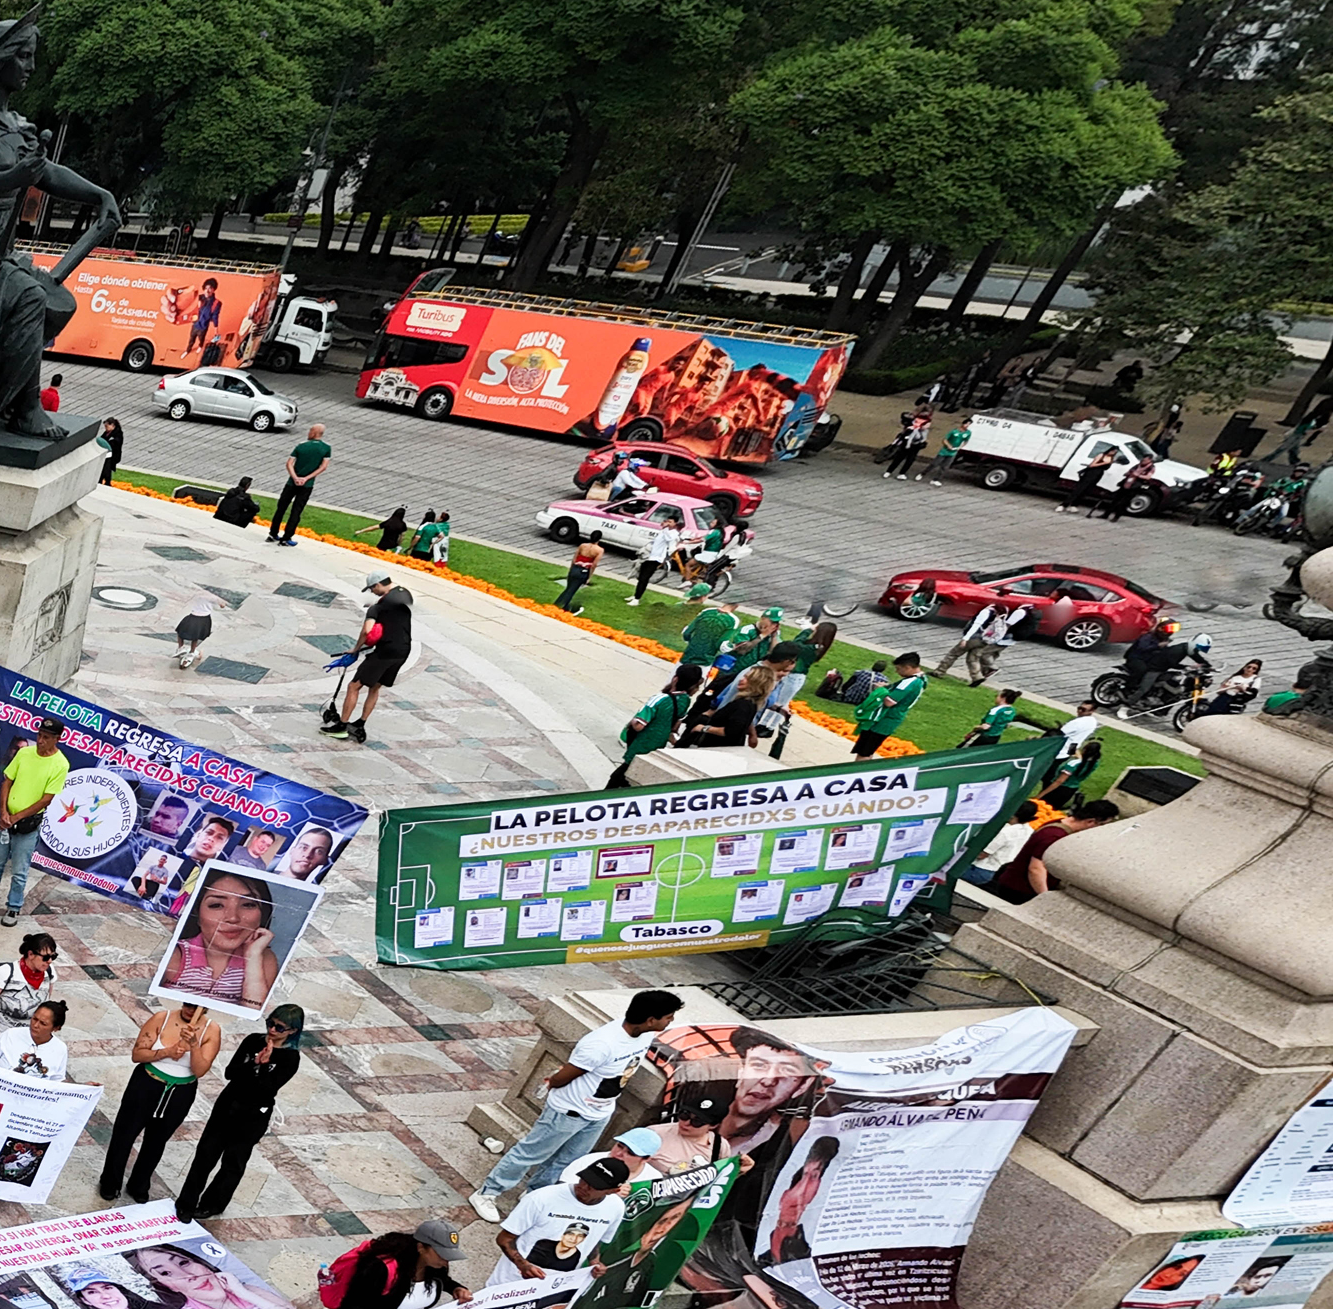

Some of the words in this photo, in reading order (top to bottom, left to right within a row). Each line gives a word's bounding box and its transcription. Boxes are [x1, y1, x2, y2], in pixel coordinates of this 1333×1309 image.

[78, 273, 100, 284] Elige
[102, 275, 129, 287] dónde
[132, 280, 168, 290] obtener
[91, 289, 116, 314] 6%
[117, 307, 159, 319] CASHBACK
[418, 307, 455, 323] Turibus
[516, 331, 549, 349] FANS
[546, 333, 566, 357] DEL
[479, 348, 570, 398] SOL
[601, 521, 617, 530] TAXI
[10, 680, 34, 701] LA
[36, 691, 103, 731] PELOTA
[104, 718, 185, 762] REGRESA
[184, 752, 202, 771] A
[202, 758, 257, 792] CASA
[494, 814, 527, 831] LA
[534, 803, 641, 828] PELOTA
[648, 786, 788, 817] REGRESA
[792, 783, 815, 802] A
[823, 773, 909, 797] CASA
[469, 826, 598, 854] ¿NUESTROS
[603, 807, 797, 838] DESAPARECIDXS
[802, 793, 930, 823] CUÁNDO?
[632, 922, 712, 939] Tabasco
[8, 1087, 60, 1103] encontrarles!
[14, 1083, 41, 1095] porque
[42, 1087, 53, 1095] les
[54, 1091, 92, 1101] amamos!
